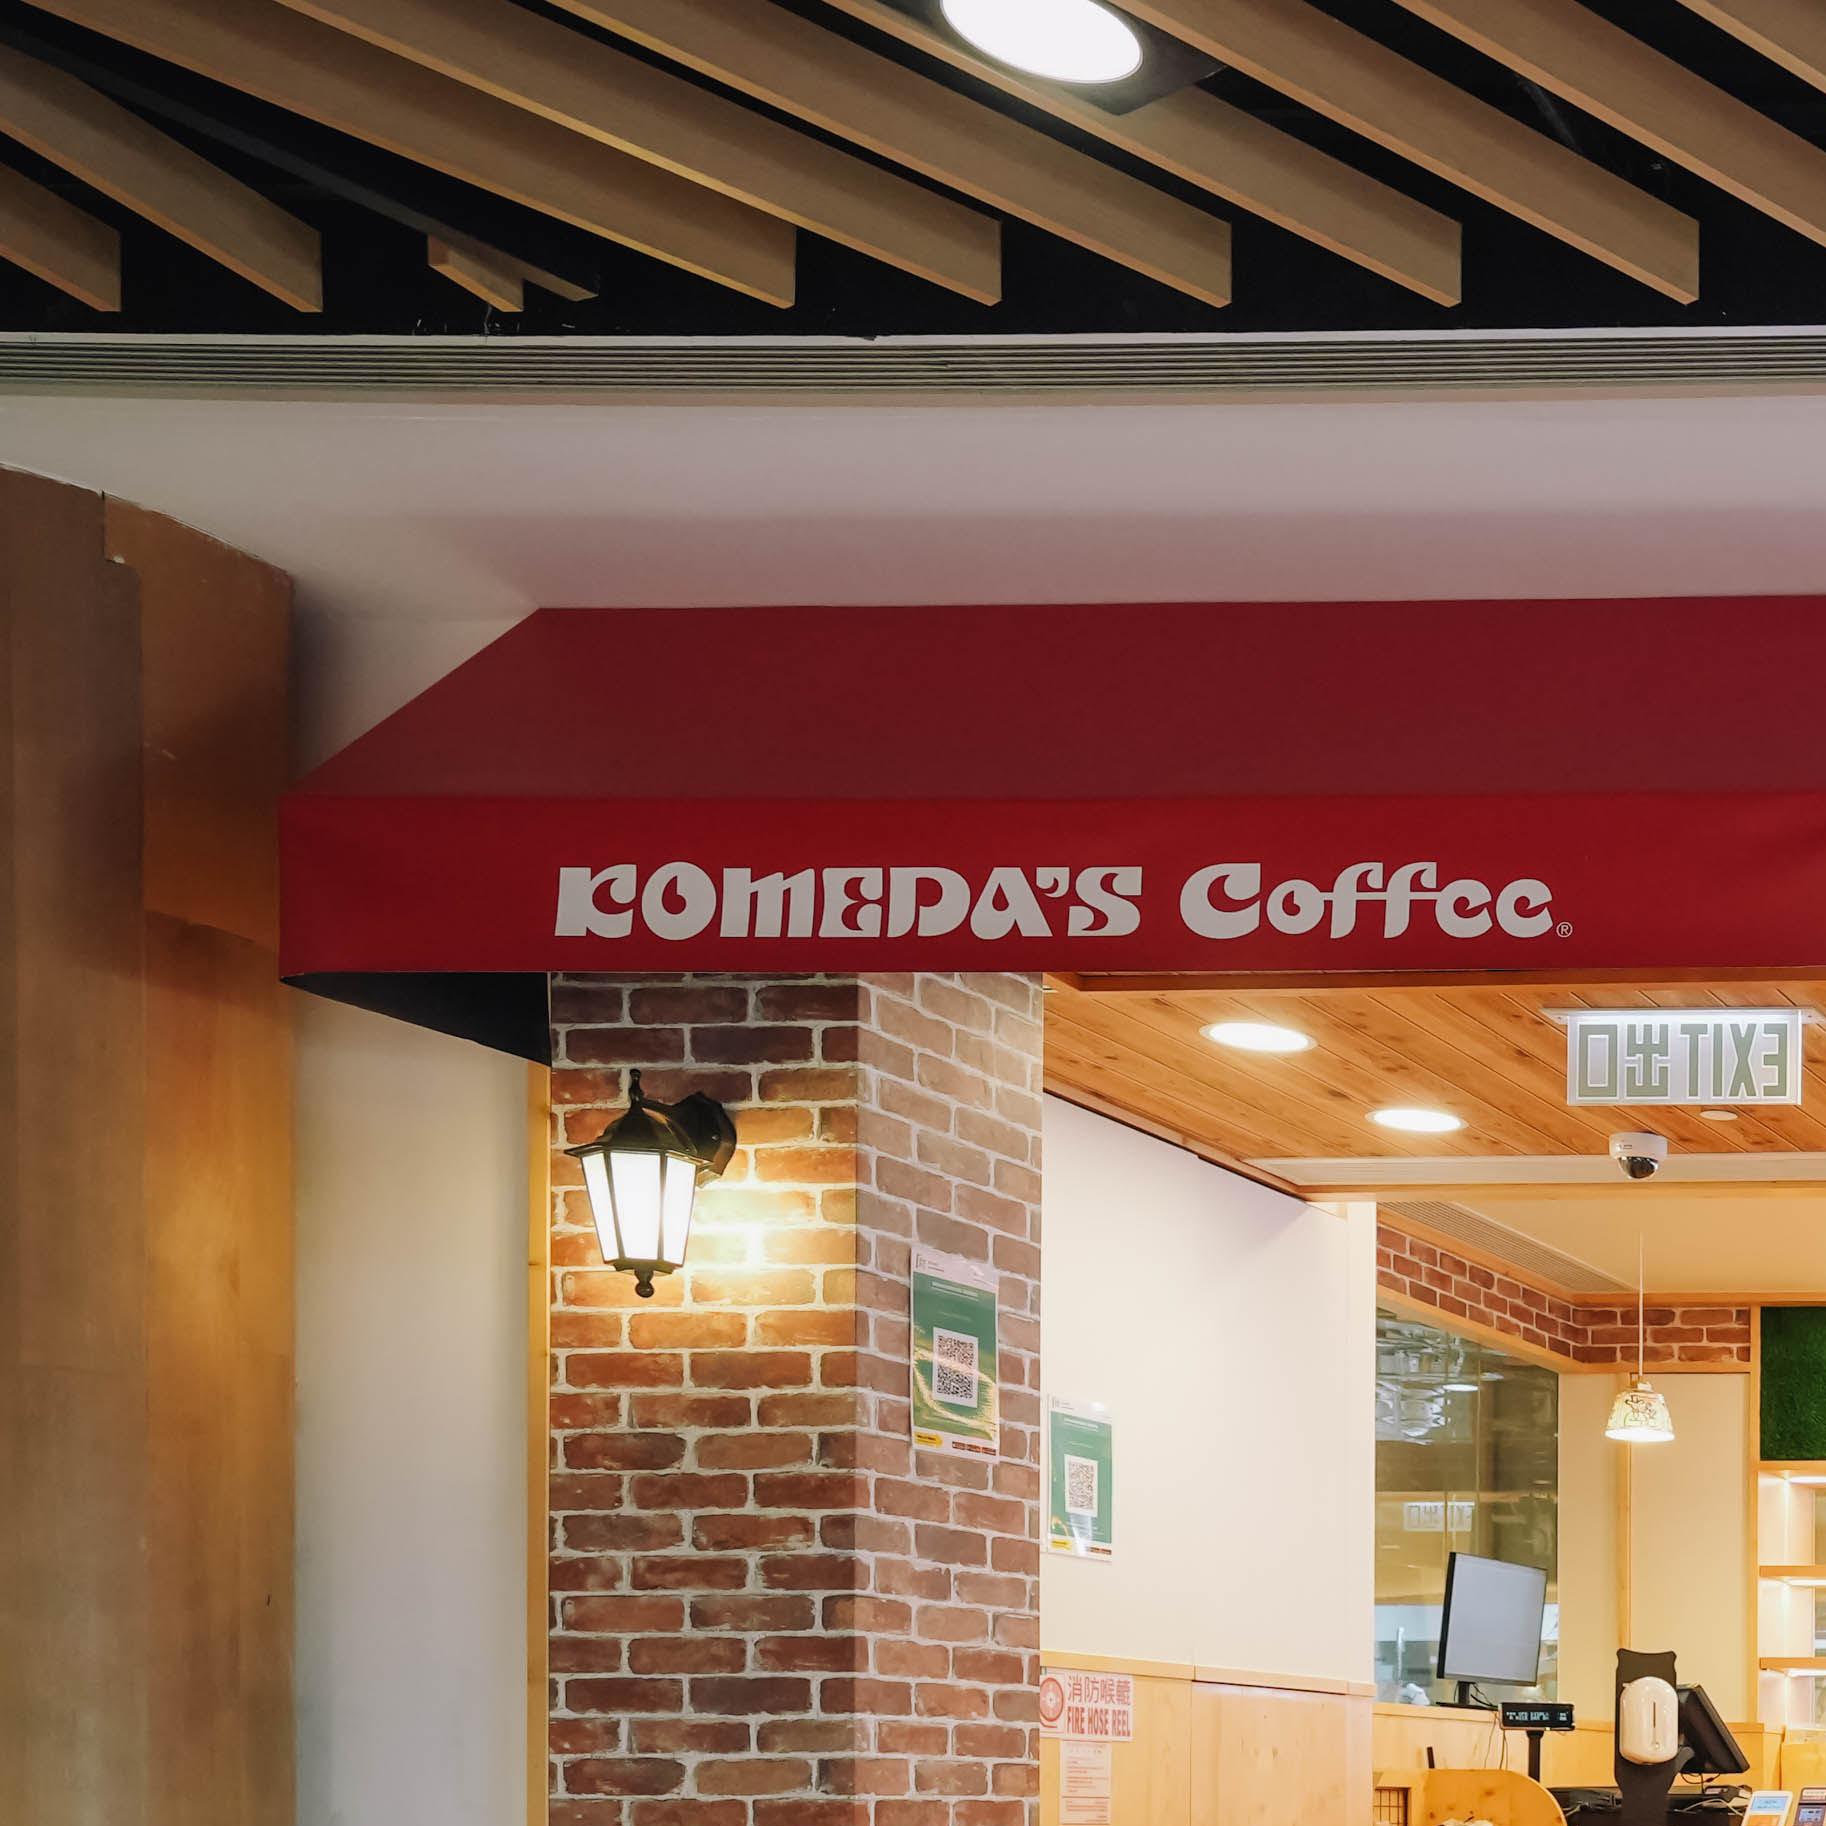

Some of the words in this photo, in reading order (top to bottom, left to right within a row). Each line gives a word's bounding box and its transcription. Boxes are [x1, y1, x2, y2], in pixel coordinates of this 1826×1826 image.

[554, 861, 1143, 940] KOMEDA'S
[1179, 861, 1553, 940] Coffee
[1067, 1706, 1085, 1735] FIRE
[1088, 1708, 1108, 1737] HOSE
[1112, 1710, 1131, 1737] REEL
